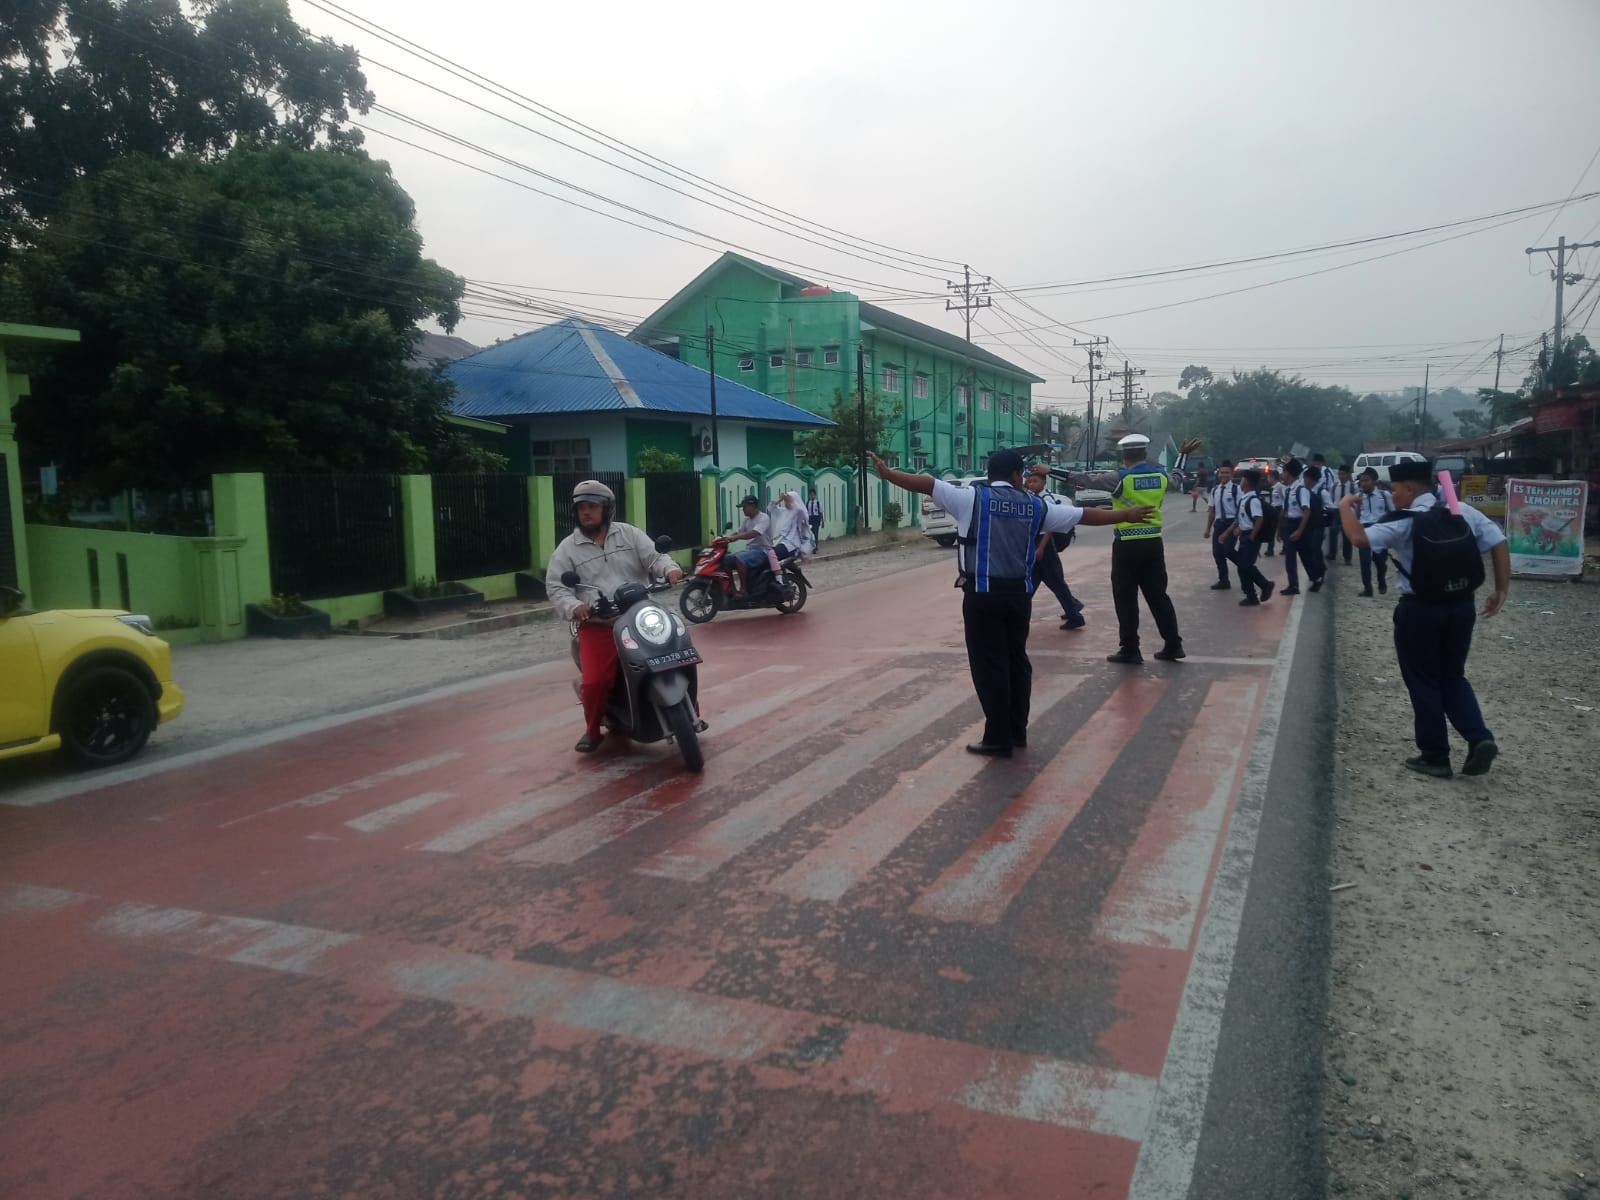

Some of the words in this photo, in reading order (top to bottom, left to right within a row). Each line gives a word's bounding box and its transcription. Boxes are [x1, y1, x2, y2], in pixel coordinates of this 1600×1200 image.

[1135, 478, 1160, 489] POLISI
[1513, 485, 1524, 493] ES
[1526, 486, 1543, 495] TEH
[1546, 487, 1581, 496] JUMBO
[1524, 496, 1559, 505] LEMON
[1562, 497, 1579, 506] TEA
[989, 500, 1034, 516] DISHUB
